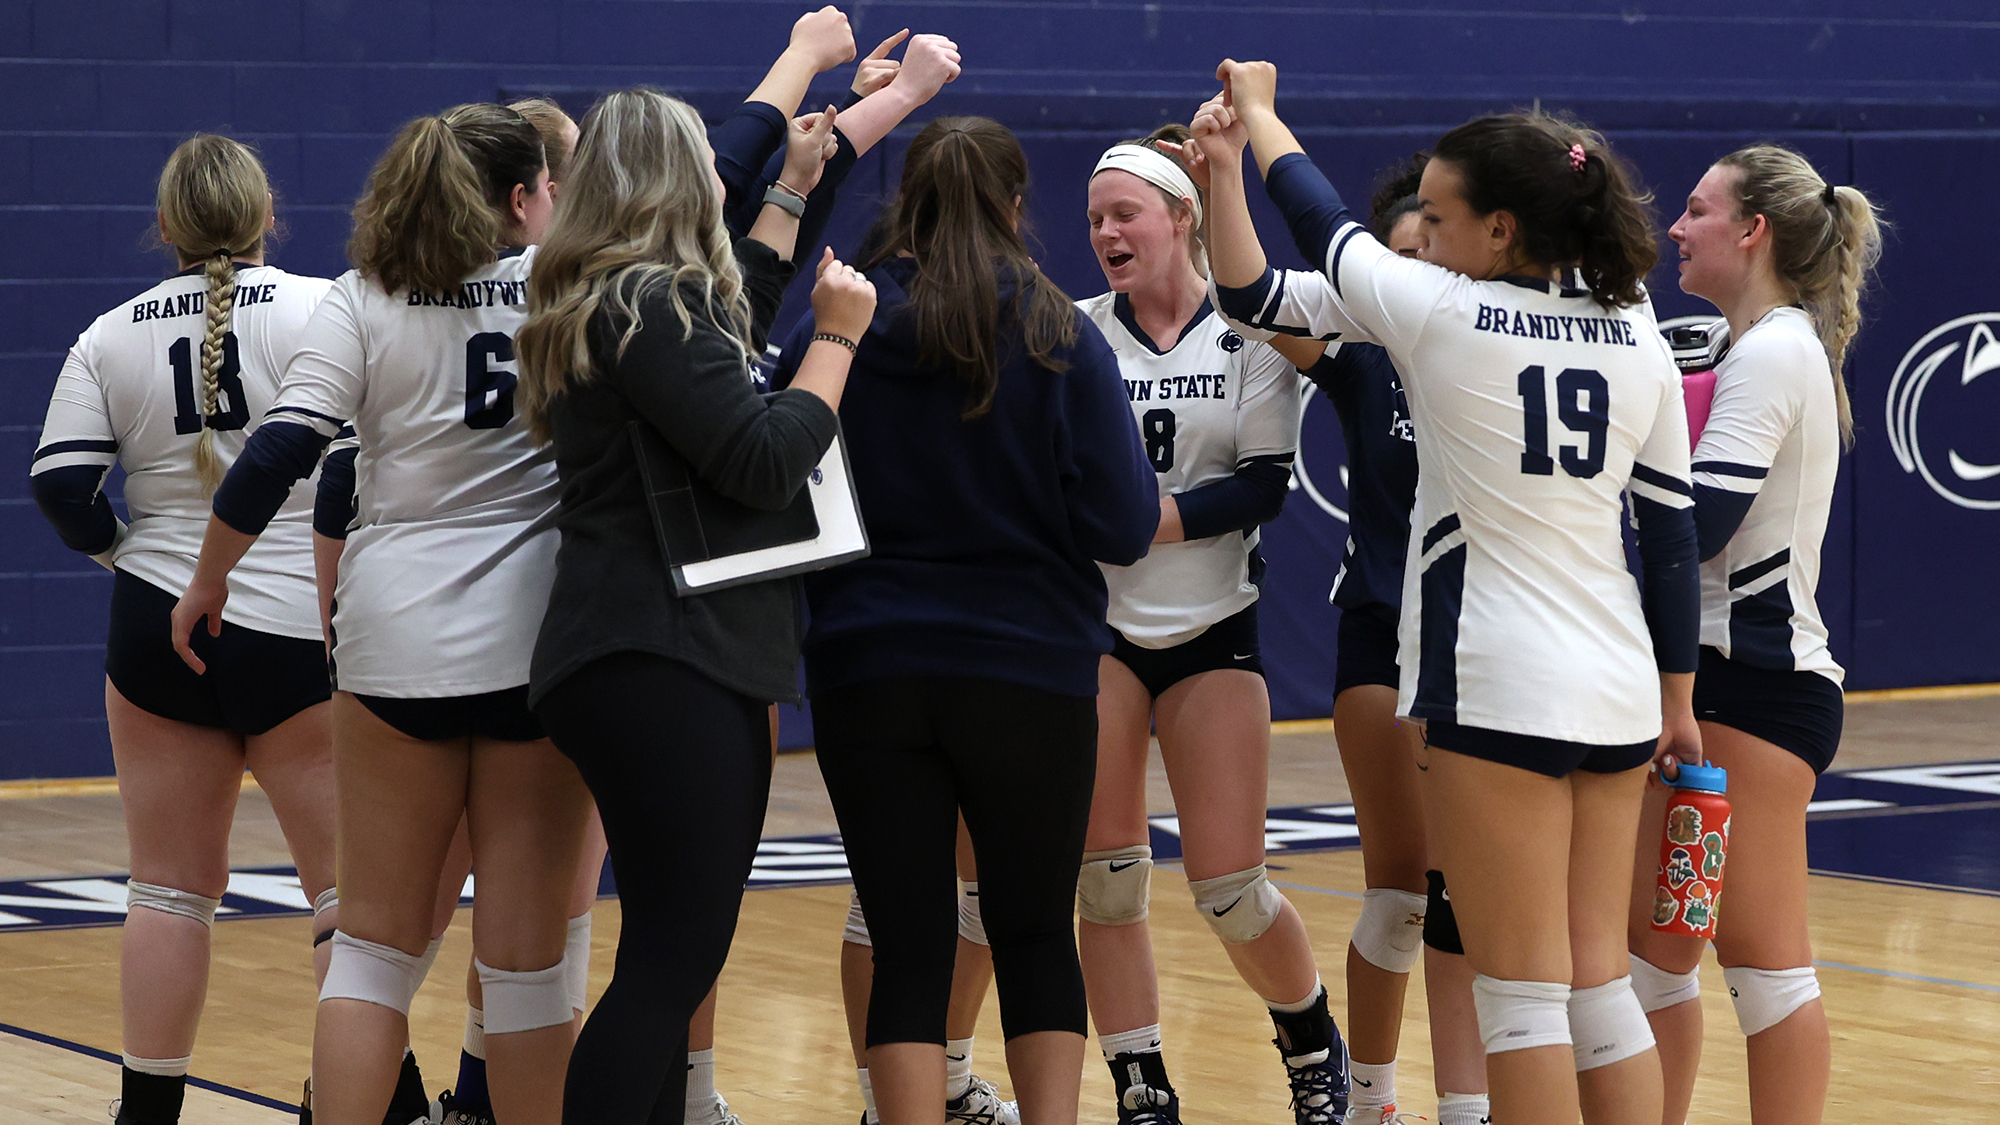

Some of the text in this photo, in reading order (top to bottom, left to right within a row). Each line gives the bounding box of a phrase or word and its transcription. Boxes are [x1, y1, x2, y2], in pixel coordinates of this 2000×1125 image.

[132, 284, 276, 323] BRANDINE
[407, 277, 529, 309] BRANDYWI
[1474, 302, 1637, 347] BRANDYWINE
[168, 331, 250, 435] 18
[464, 331, 518, 429] 6
[1123, 374, 1225, 401] NN STATE
[1142, 408, 1176, 473] 8
[1517, 364, 1610, 479] 19
